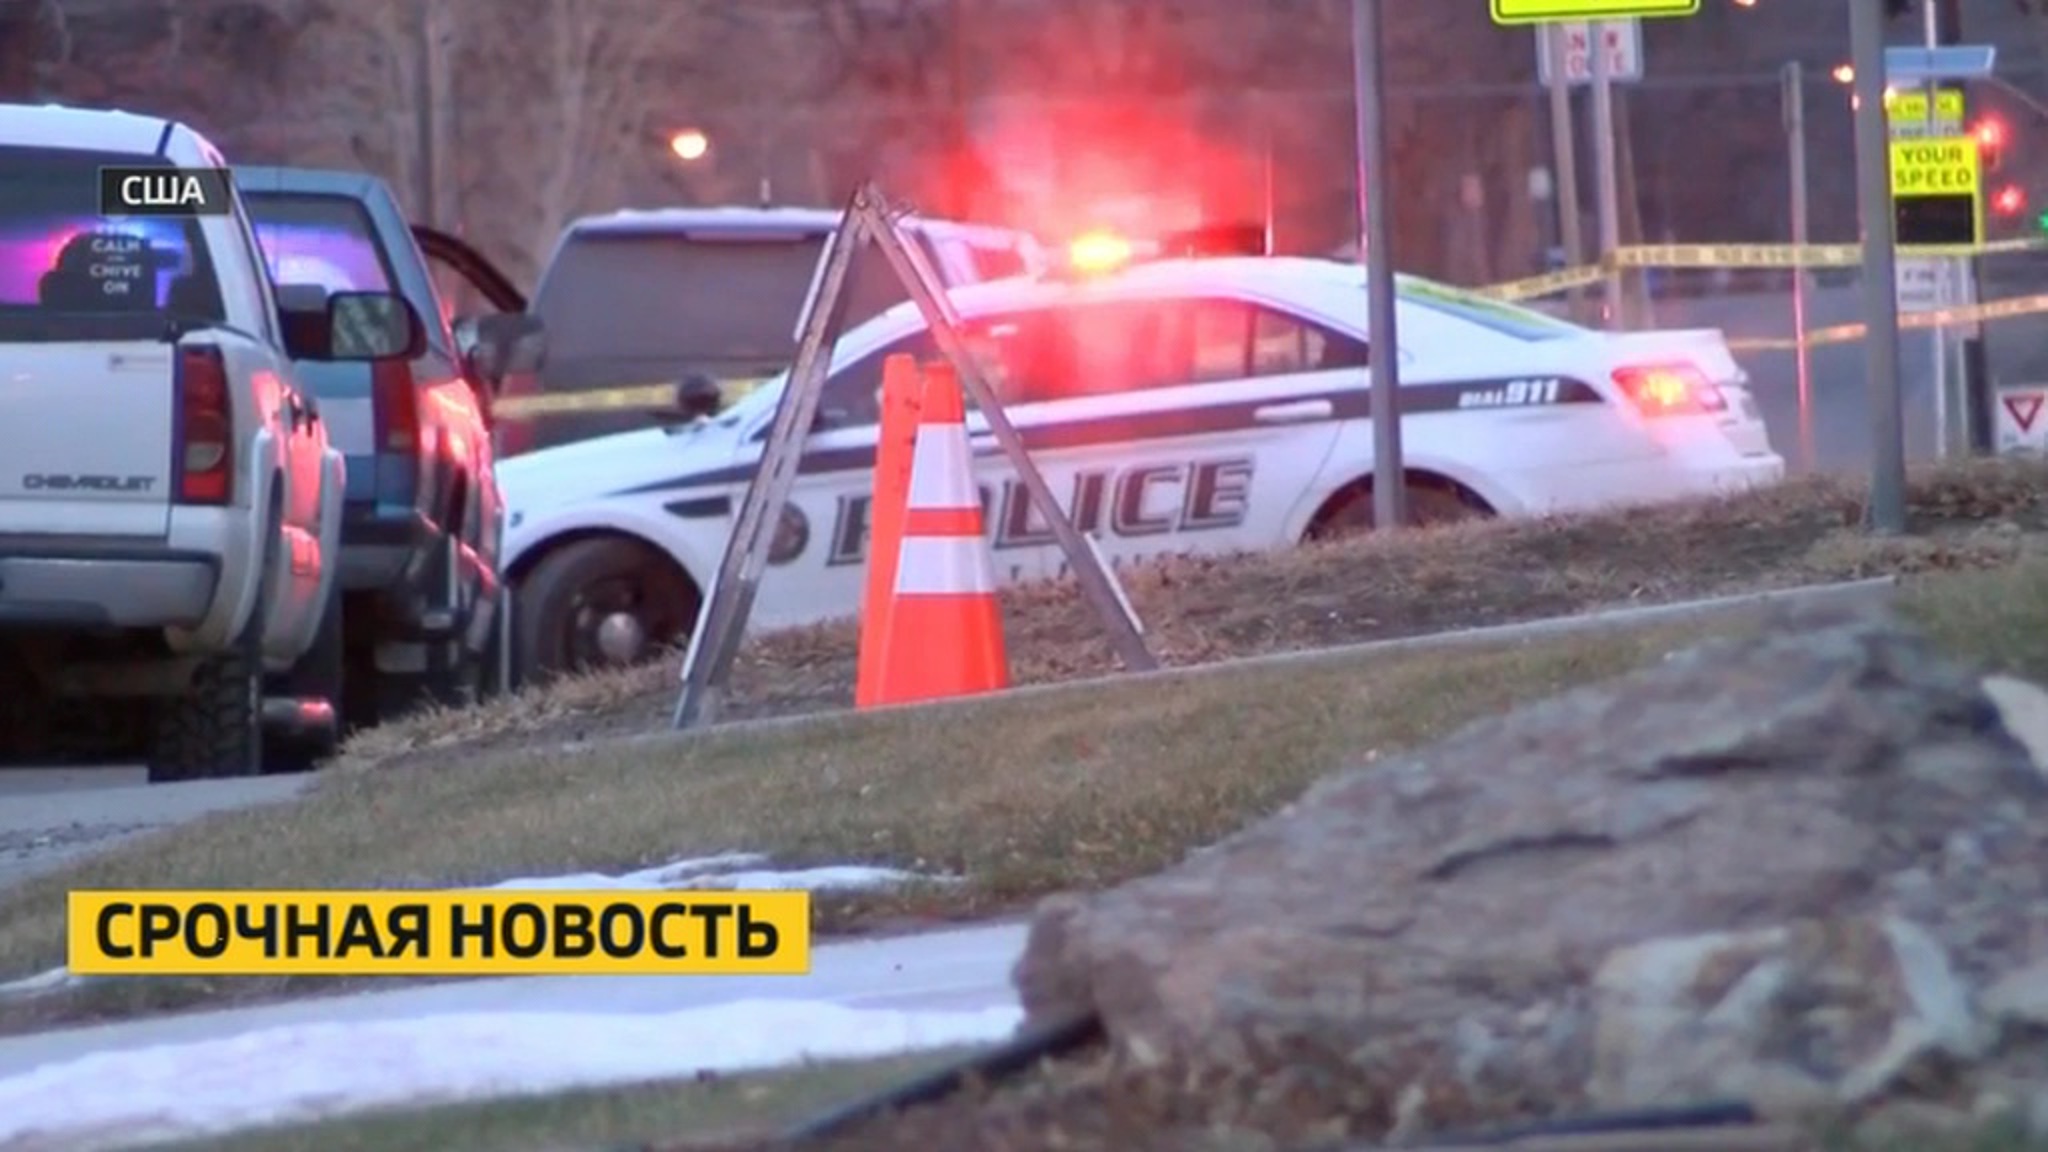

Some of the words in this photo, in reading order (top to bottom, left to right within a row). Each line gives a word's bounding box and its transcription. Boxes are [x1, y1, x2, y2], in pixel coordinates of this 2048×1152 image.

[1900, 146, 1963, 164] YOUR
[1895, 168, 1971, 188] SPEED
[91, 239, 140, 253] CALM
[1506, 379, 1559, 404] 911
[22, 474, 156, 491] CHEVROLET
[826, 459, 1254, 567] PLICE
